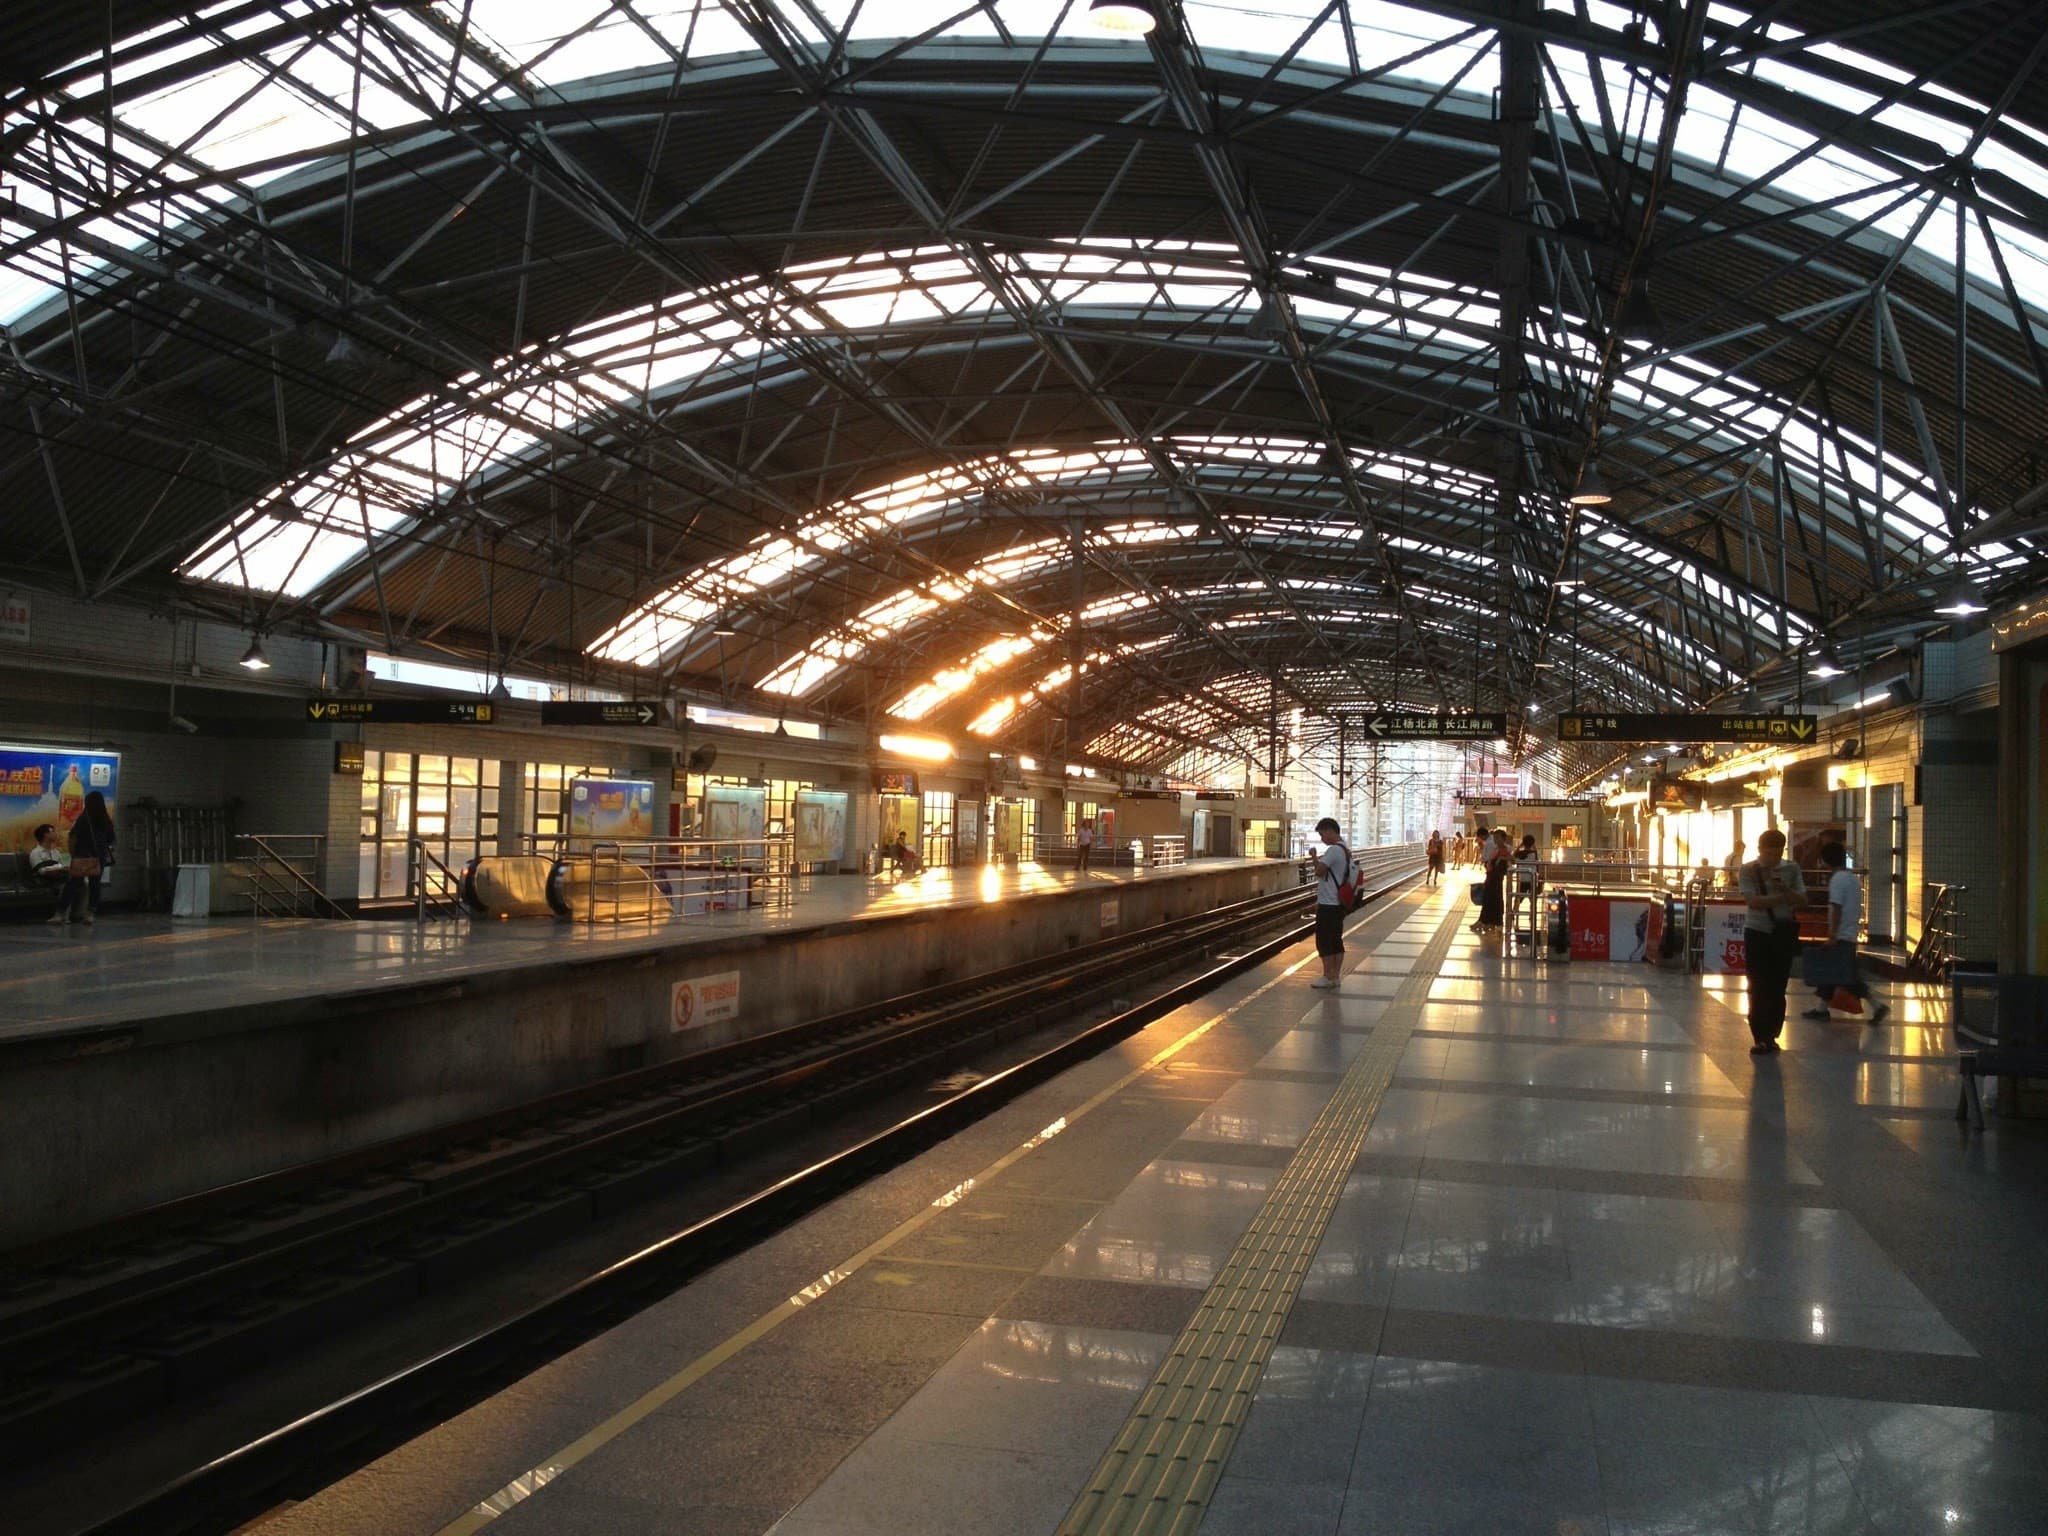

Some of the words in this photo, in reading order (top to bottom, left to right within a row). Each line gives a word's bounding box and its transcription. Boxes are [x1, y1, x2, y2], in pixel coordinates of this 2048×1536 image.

[1390, 717, 1439, 729] 江杨北路
[1444, 717, 1493, 729] 长江南路
[1584, 718, 1617, 728] 三号线
